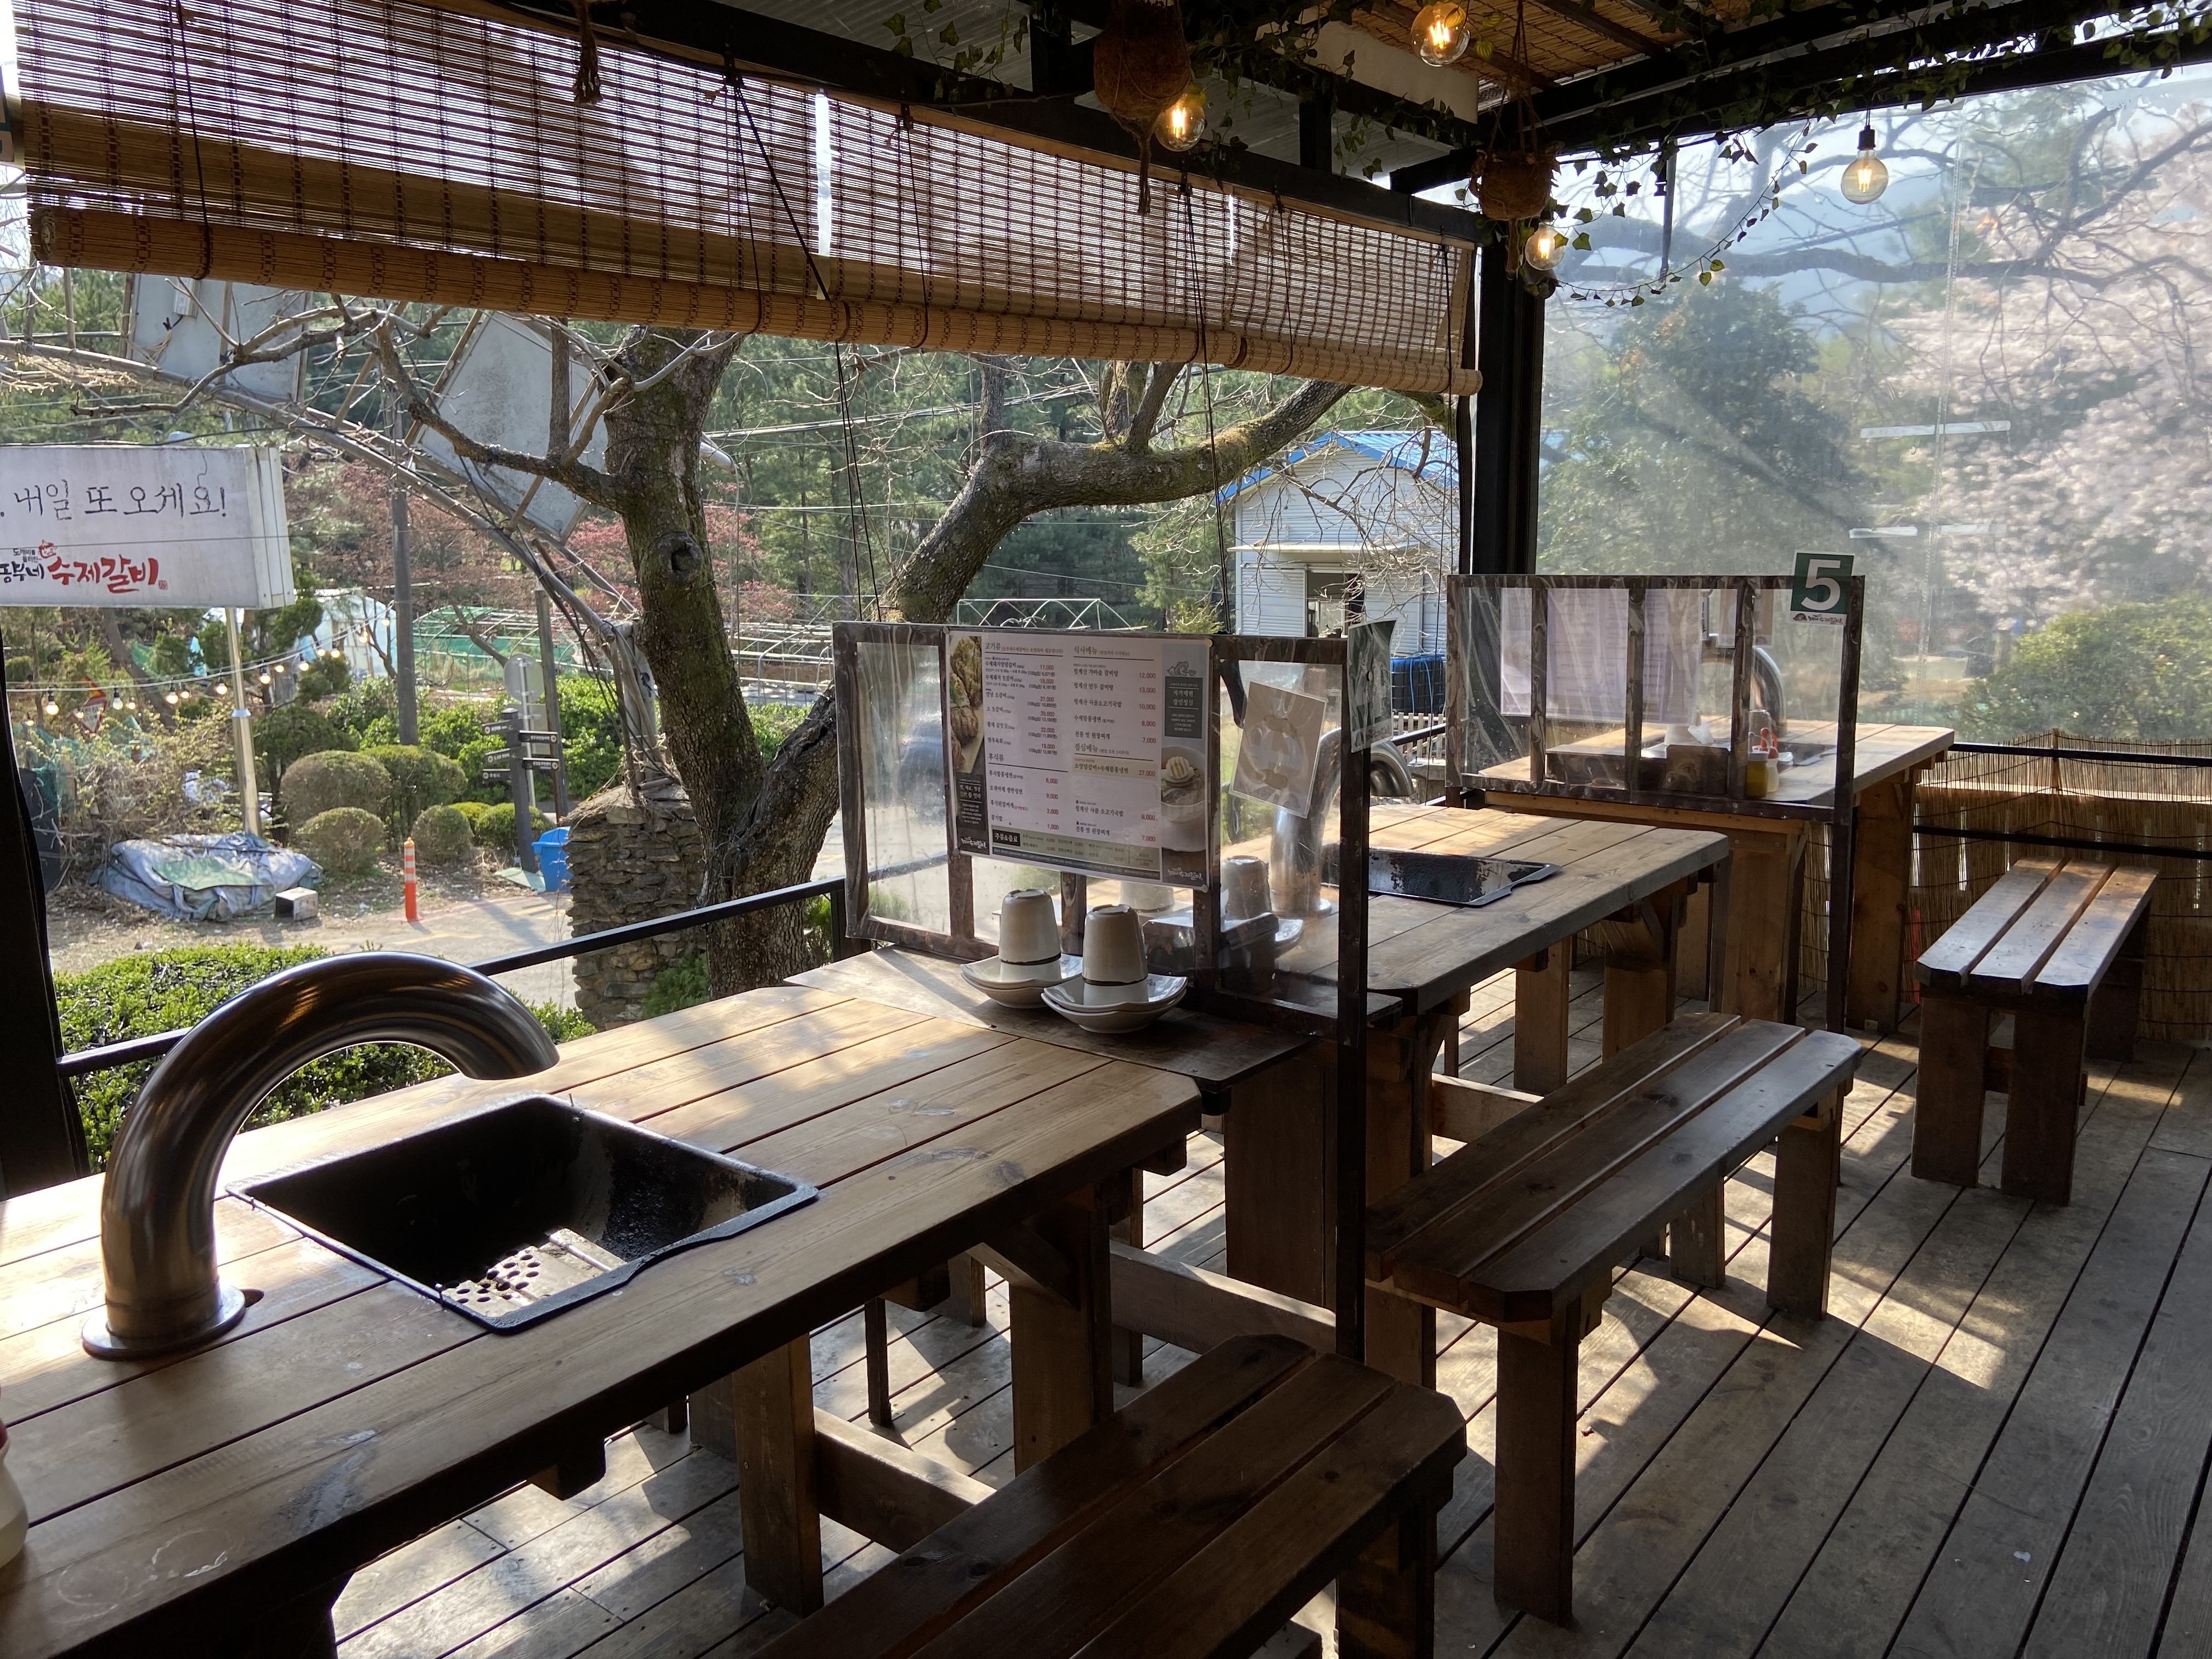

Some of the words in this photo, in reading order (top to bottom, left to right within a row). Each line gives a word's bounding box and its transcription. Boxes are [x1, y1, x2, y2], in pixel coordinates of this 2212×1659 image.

[14, 479, 71, 520] 내일
[85, 486, 117, 515] 또
[123, 483, 227, 518] 오세요!
[47, 554, 159, 593] 수제갈비
[1801, 558, 1841, 611] 5
[985, 642, 1001, 651] 고기류
[1074, 646, 1098, 655] 식사메뉴
[1089, 699, 1122, 708] 사골소고기국밥
[1074, 715, 1101, 723] 수제함흥냉면
[1075, 743, 1098, 753] 점심메뉴
[988, 753, 1005, 762] 후식류
[989, 770, 1013, 778] 후식함흥냉면
[1101, 809, 1124, 817] 소고기국밥
[1091, 828, 1110, 836] 된장찌개
[995, 832, 1018, 842] 주류&음료
